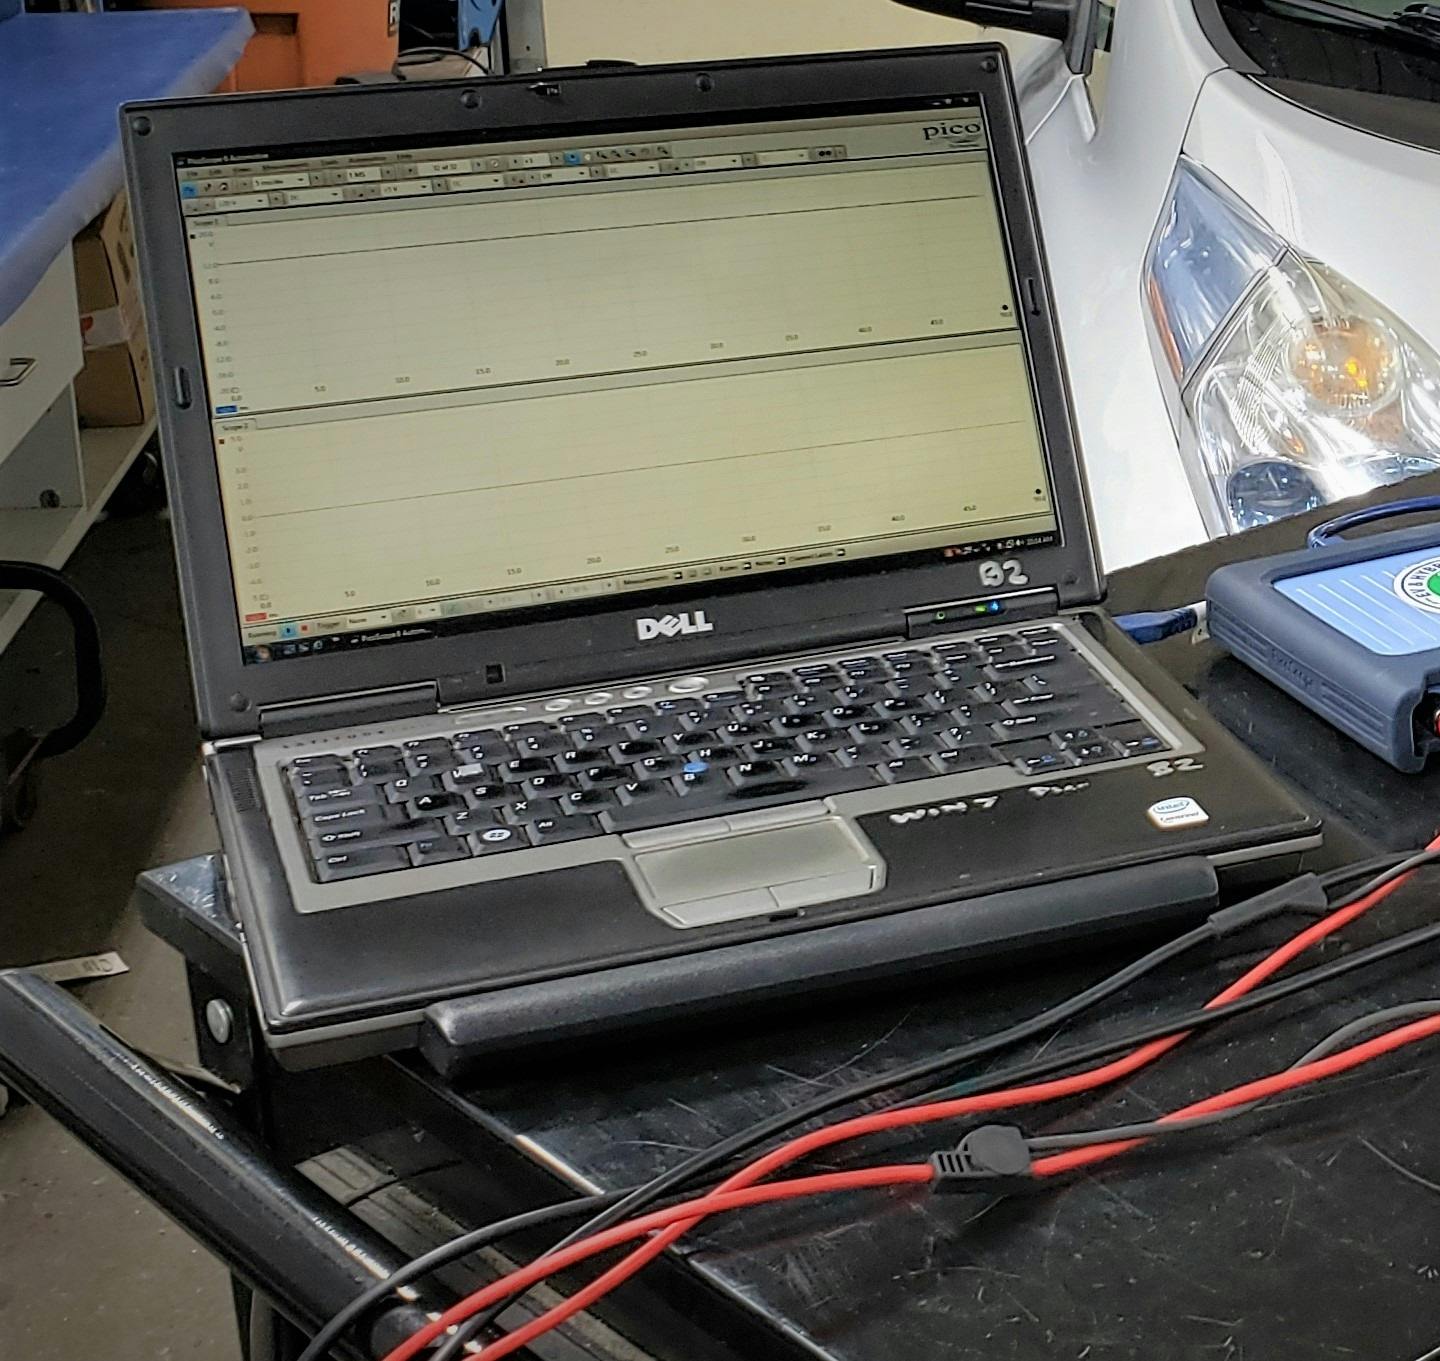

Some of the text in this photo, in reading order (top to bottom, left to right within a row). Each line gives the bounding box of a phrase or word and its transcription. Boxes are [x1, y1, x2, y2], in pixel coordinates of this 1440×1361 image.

[922, 121, 982, 141] pico
[978, 559, 1029, 588] B2
[636, 609, 714, 642] DELL
[859, 723, 870, 731] L
[806, 731, 819, 740] K
[699, 748, 712, 757] H
[793, 754, 809, 763] M
[739, 763, 752, 772] N
[474, 786, 488, 796] S
[626, 783, 638, 792] V
[418, 795, 432, 805] A
[570, 791, 583, 801] C
[514, 800, 528, 811] X
[313, 808, 366, 823] Caps Lock
[455, 810, 469, 821] Z
